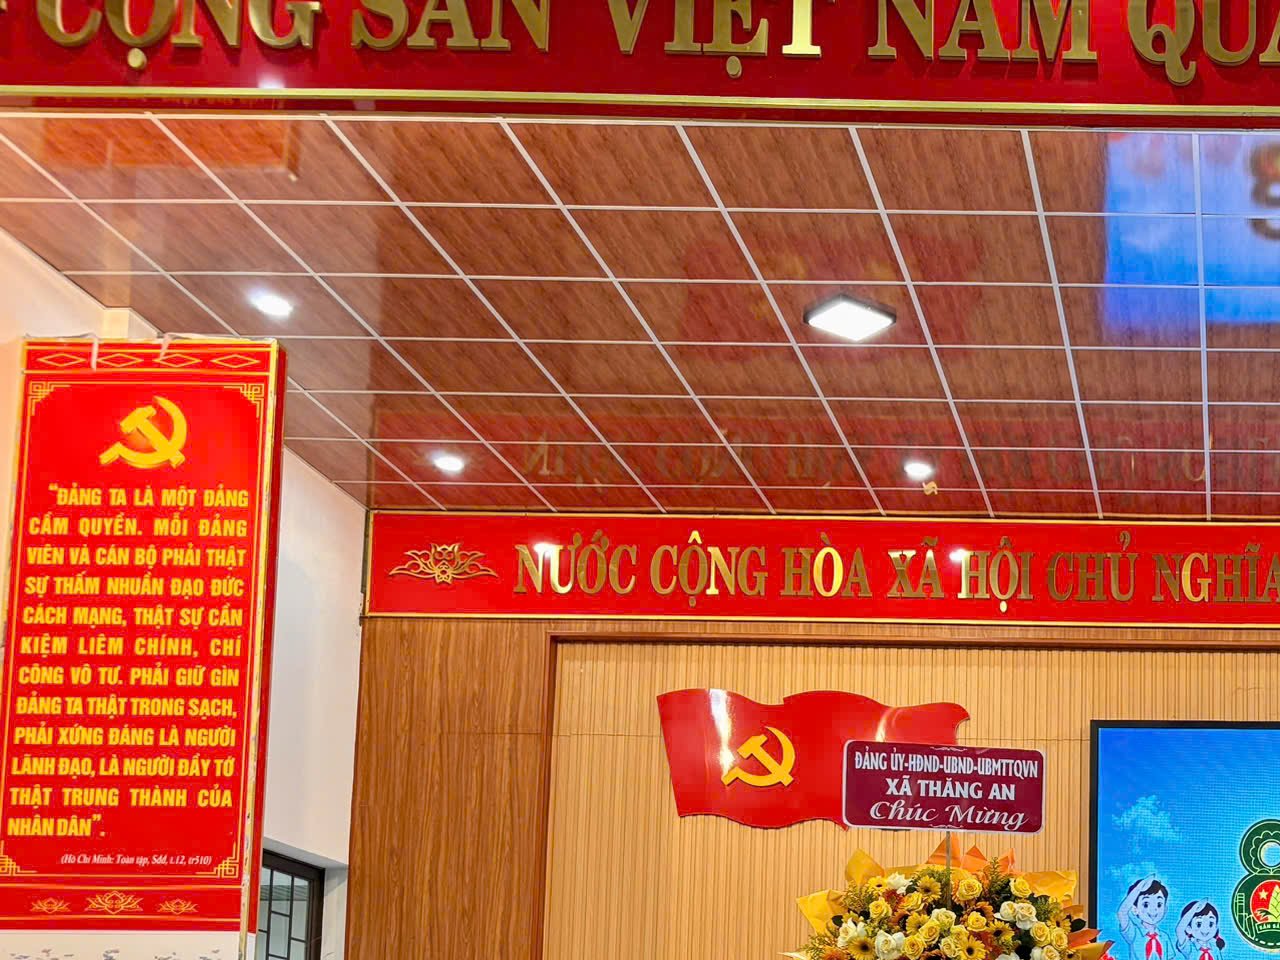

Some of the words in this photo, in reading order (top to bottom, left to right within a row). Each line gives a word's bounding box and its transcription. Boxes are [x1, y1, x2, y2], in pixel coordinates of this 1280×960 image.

[867, 0, 1098, 60] NAM
[109, 489, 127, 506] TA
[134, 485, 154, 506] LÀ
[162, 486, 196, 510] MỘT
[203, 484, 248, 507] ĐẢNG
[29, 512, 69, 535] CẦM
[79, 513, 142, 536] QUYỀN.
[154, 513, 188, 535] MỖI
[199, 514, 247, 537] ĐẢNG
[27, 544, 64, 565] VIÊN
[70, 544, 90, 564] VÀ
[96, 544, 129, 565] CÁN
[134, 545, 156, 569] BỘ
[162, 543, 201, 566] PHẢI
[208, 546, 246, 570] THẬT
[513, 530, 636, 595] NƯỚC
[650, 531, 768, 606] CỘNG
[780, 531, 872, 598] HÒA
[888, 537, 944, 598] XÃ
[957, 536, 1032, 612] HỘI
[1047, 530, 1136, 603] CHỦ
[21, 634, 67, 657] KIỆM
[79, 634, 124, 654] LIÊM
[134, 636, 198, 657] CHÍNH,
[210, 636, 241, 657] CHÍ
[16, 691, 61, 714] ĐẢNG
[65, 698, 83, 714] TA
[87, 695, 127, 719] THẬT
[131, 698, 184, 716] TRONG
[188, 699, 237, 719] SẠCH,
[855, 746, 887, 770] ĐẢNG
[10, 785, 52, 808] THẬT
[63, 788, 119, 806] TRUNG
[130, 786, 186, 807] THÀNH
[197, 785, 232, 807] CỦA
[886, 775, 912, 795] XÃ
[917, 777, 983, 799] THĂNG
[988, 784, 1015, 800] AN
[8, 816, 54, 836] NHÂN
[870, 799, 939, 822] Chúc
[945, 804, 1029, 831] Mừng
